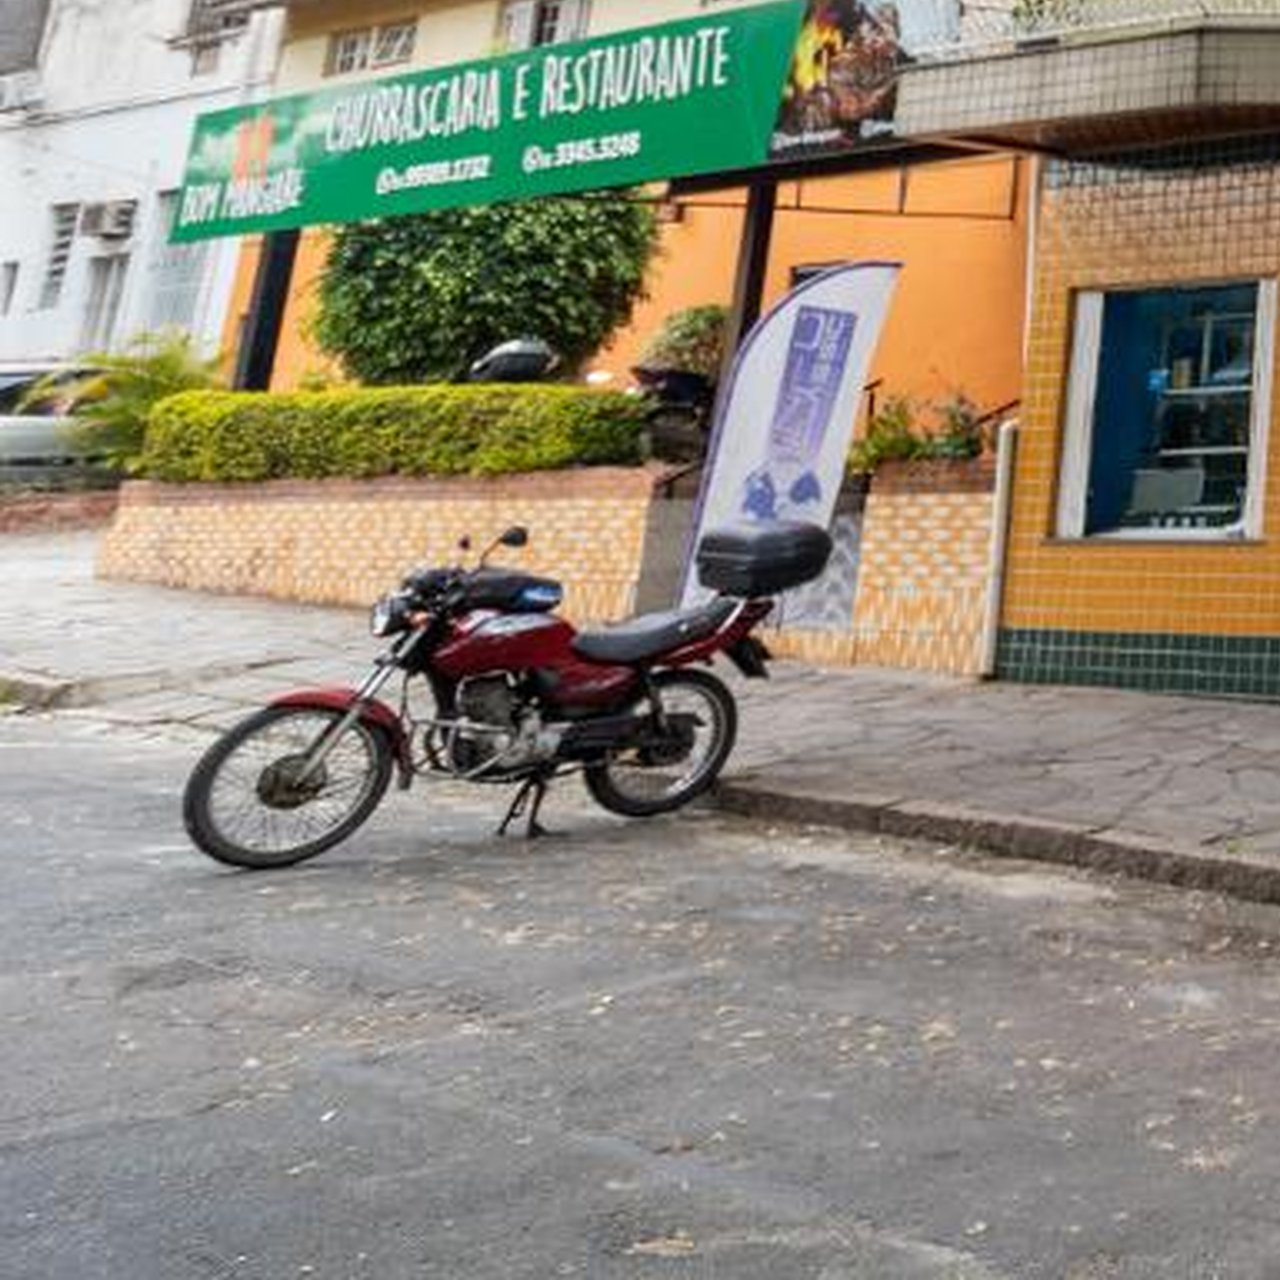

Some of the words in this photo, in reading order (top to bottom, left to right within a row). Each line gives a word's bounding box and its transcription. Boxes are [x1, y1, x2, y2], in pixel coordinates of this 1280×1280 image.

[326, 69, 499, 151] CHURRASCARIA
[511, 62, 532, 121] E
[539, 26, 730, 118] RESTAURANTE
